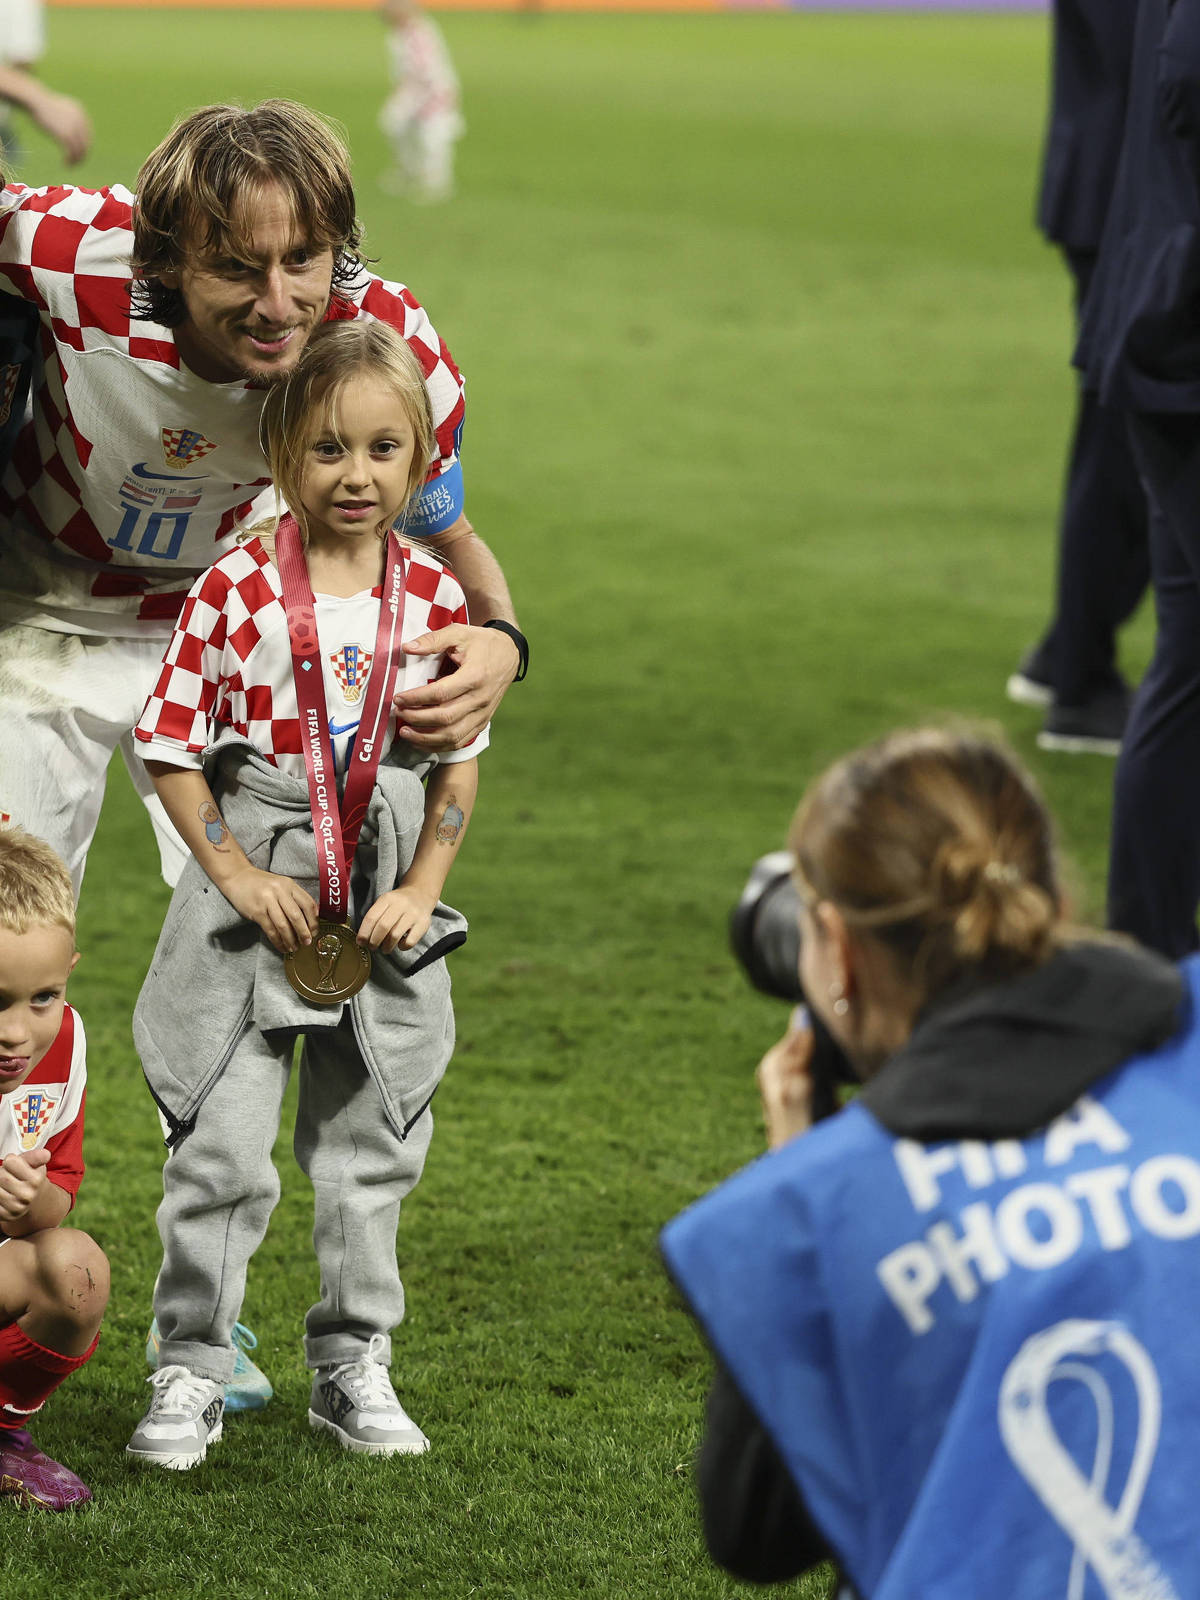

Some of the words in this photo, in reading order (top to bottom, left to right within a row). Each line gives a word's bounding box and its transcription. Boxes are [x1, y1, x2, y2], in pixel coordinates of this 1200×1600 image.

[107, 501, 193, 560] 10
[347, 650, 355, 680] HNS
[307, 708, 319, 736] FIFA
[310, 737, 325, 784] WORLD
[316, 785, 329, 810] CUP
[29, 1098, 38, 1128] HNS
[877, 1154, 1200, 1335] PHOTO
